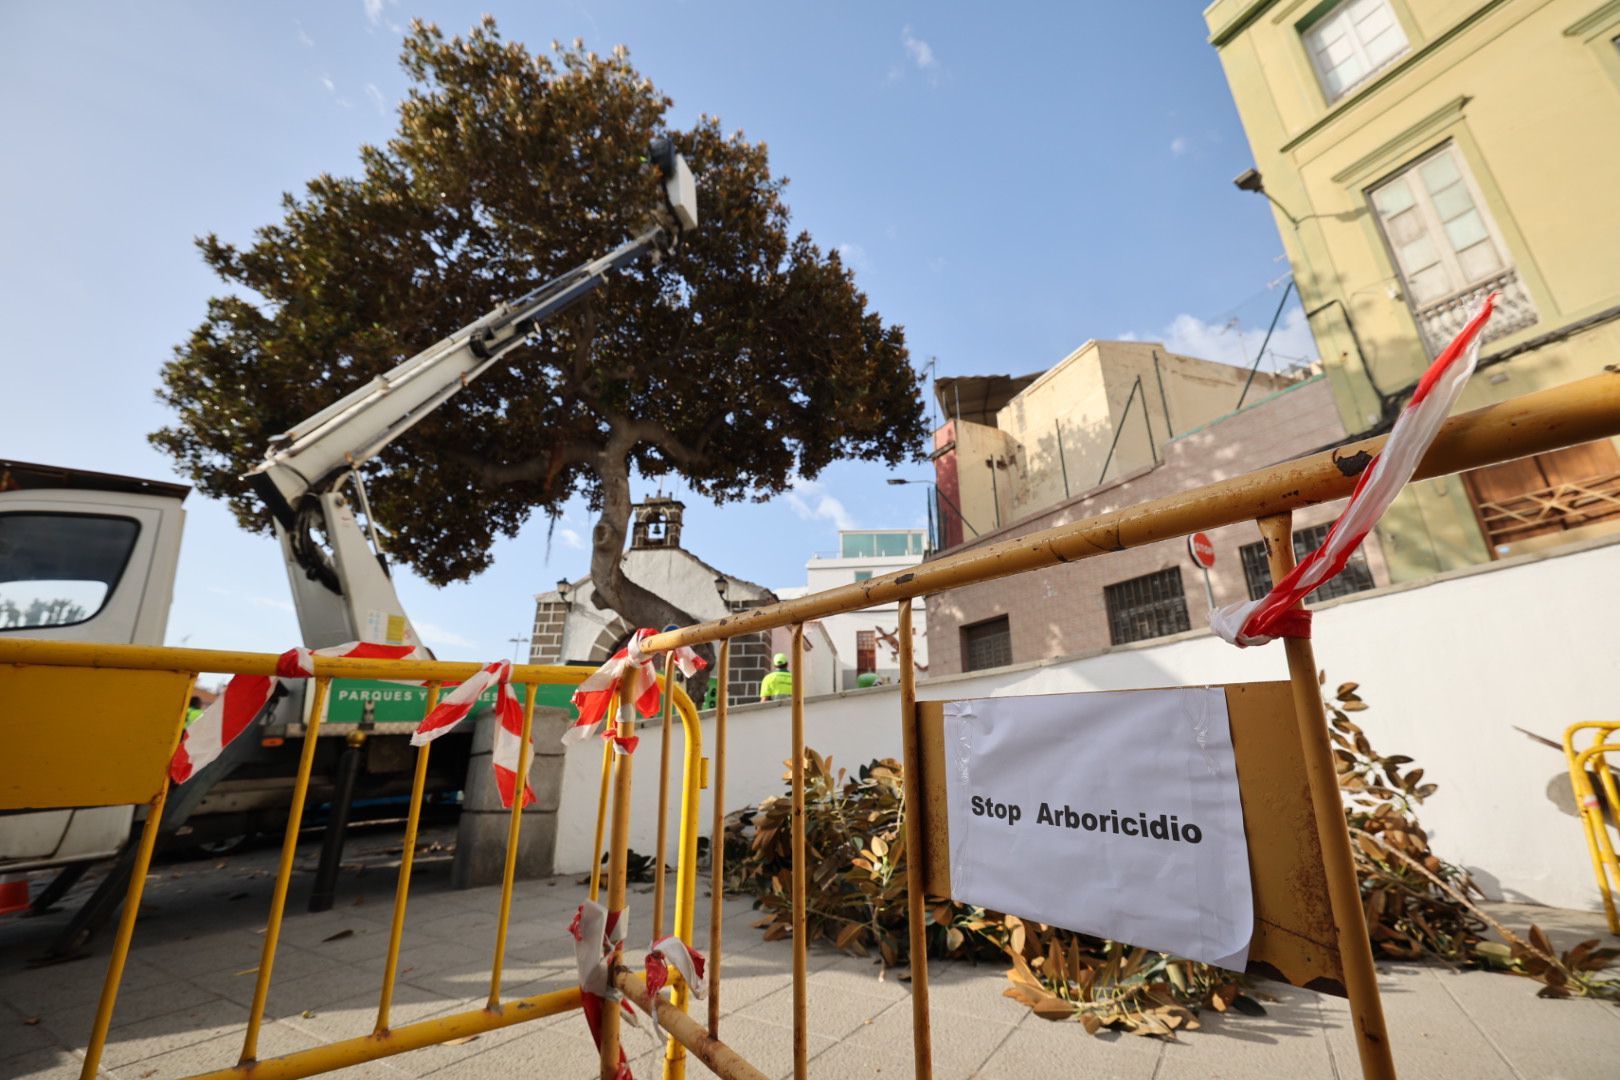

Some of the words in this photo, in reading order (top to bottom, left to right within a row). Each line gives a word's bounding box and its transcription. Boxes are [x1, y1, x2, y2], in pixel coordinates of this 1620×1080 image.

[338, 690, 412, 701] PARQUES
[419, 691, 428, 701] Y
[971, 795, 1022, 825] Stop
[1036, 802, 1203, 844] Arboricidio
